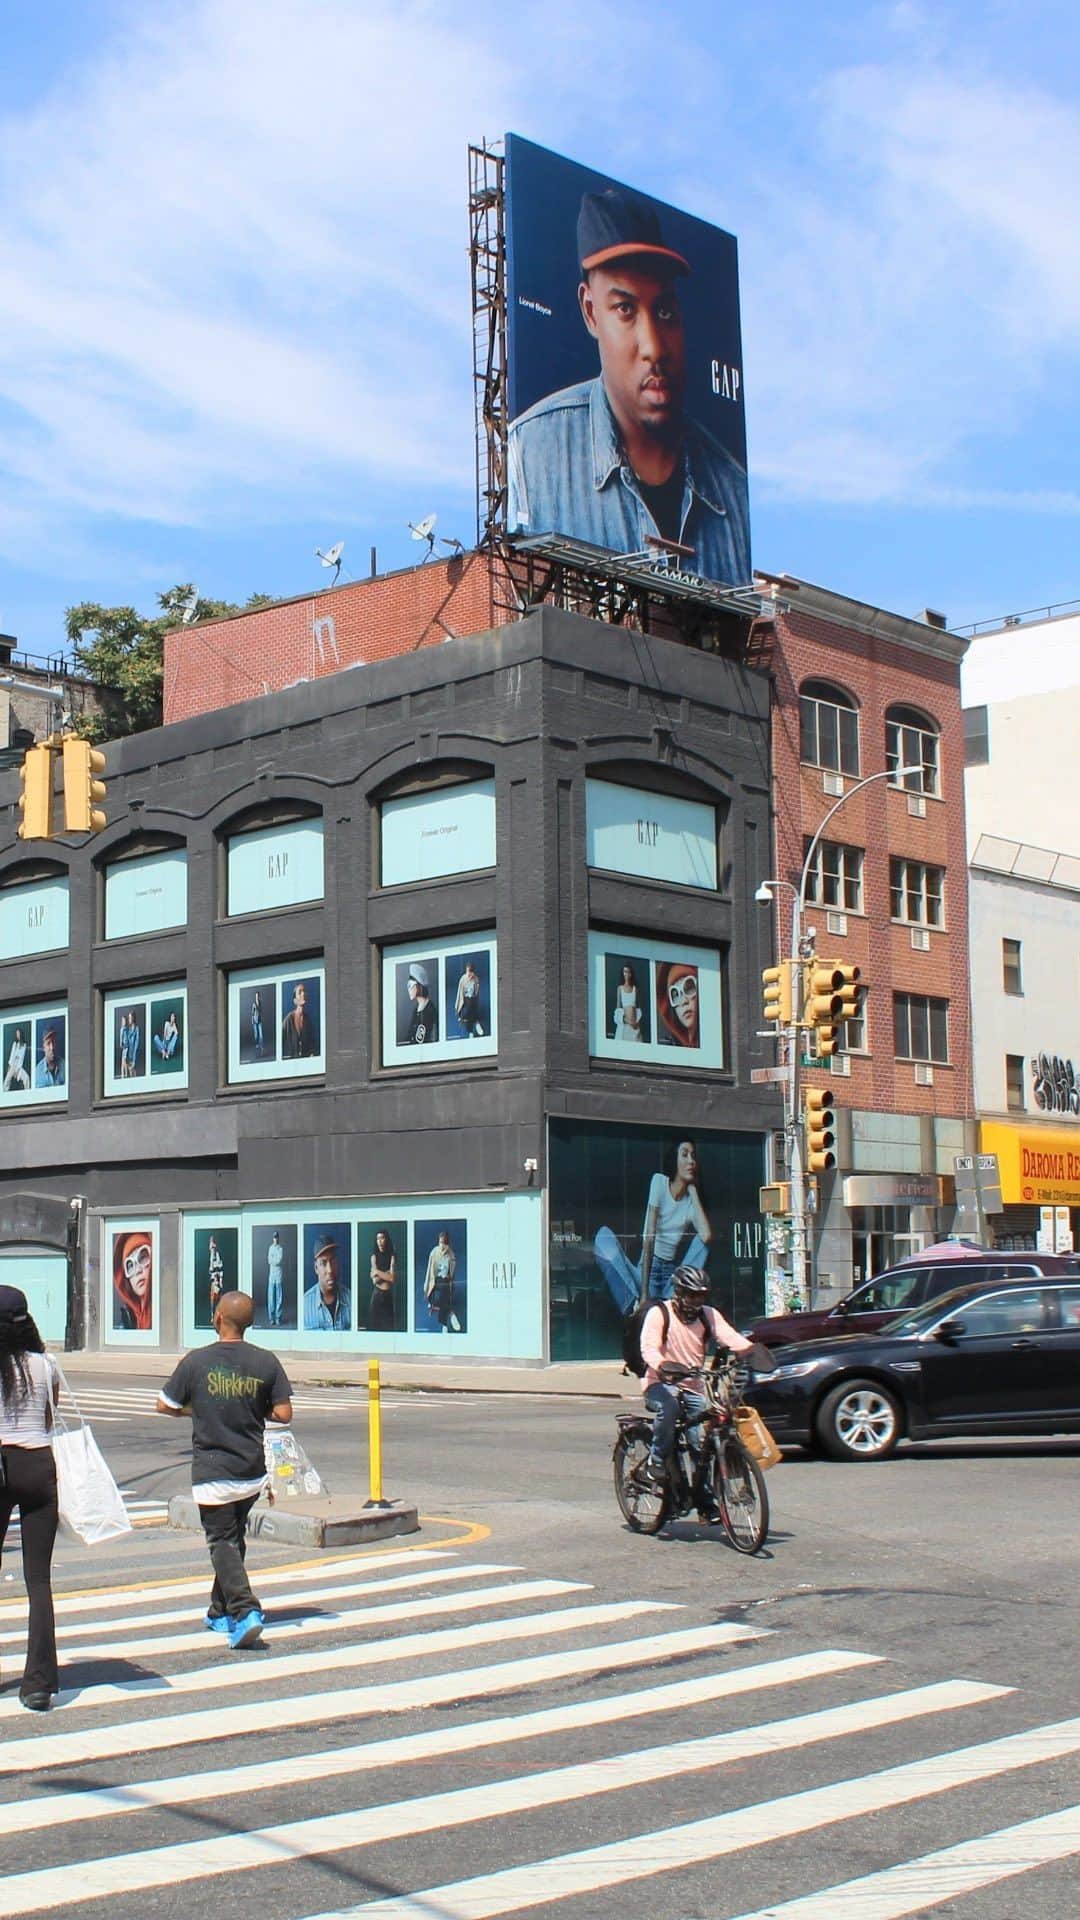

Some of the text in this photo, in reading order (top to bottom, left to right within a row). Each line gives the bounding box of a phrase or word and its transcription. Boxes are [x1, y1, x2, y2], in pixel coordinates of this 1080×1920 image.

[711, 359, 740, 401] GAP
[654, 564, 704, 587] LAMAR
[637, 818, 659, 847] GAP
[268, 851, 289, 879] GAP
[27, 904, 45, 928] GAP
[1022, 1148, 1064, 1180] DAROMA
[734, 1222, 762, 1258] GAP
[491, 1261, 517, 1289] GAP
